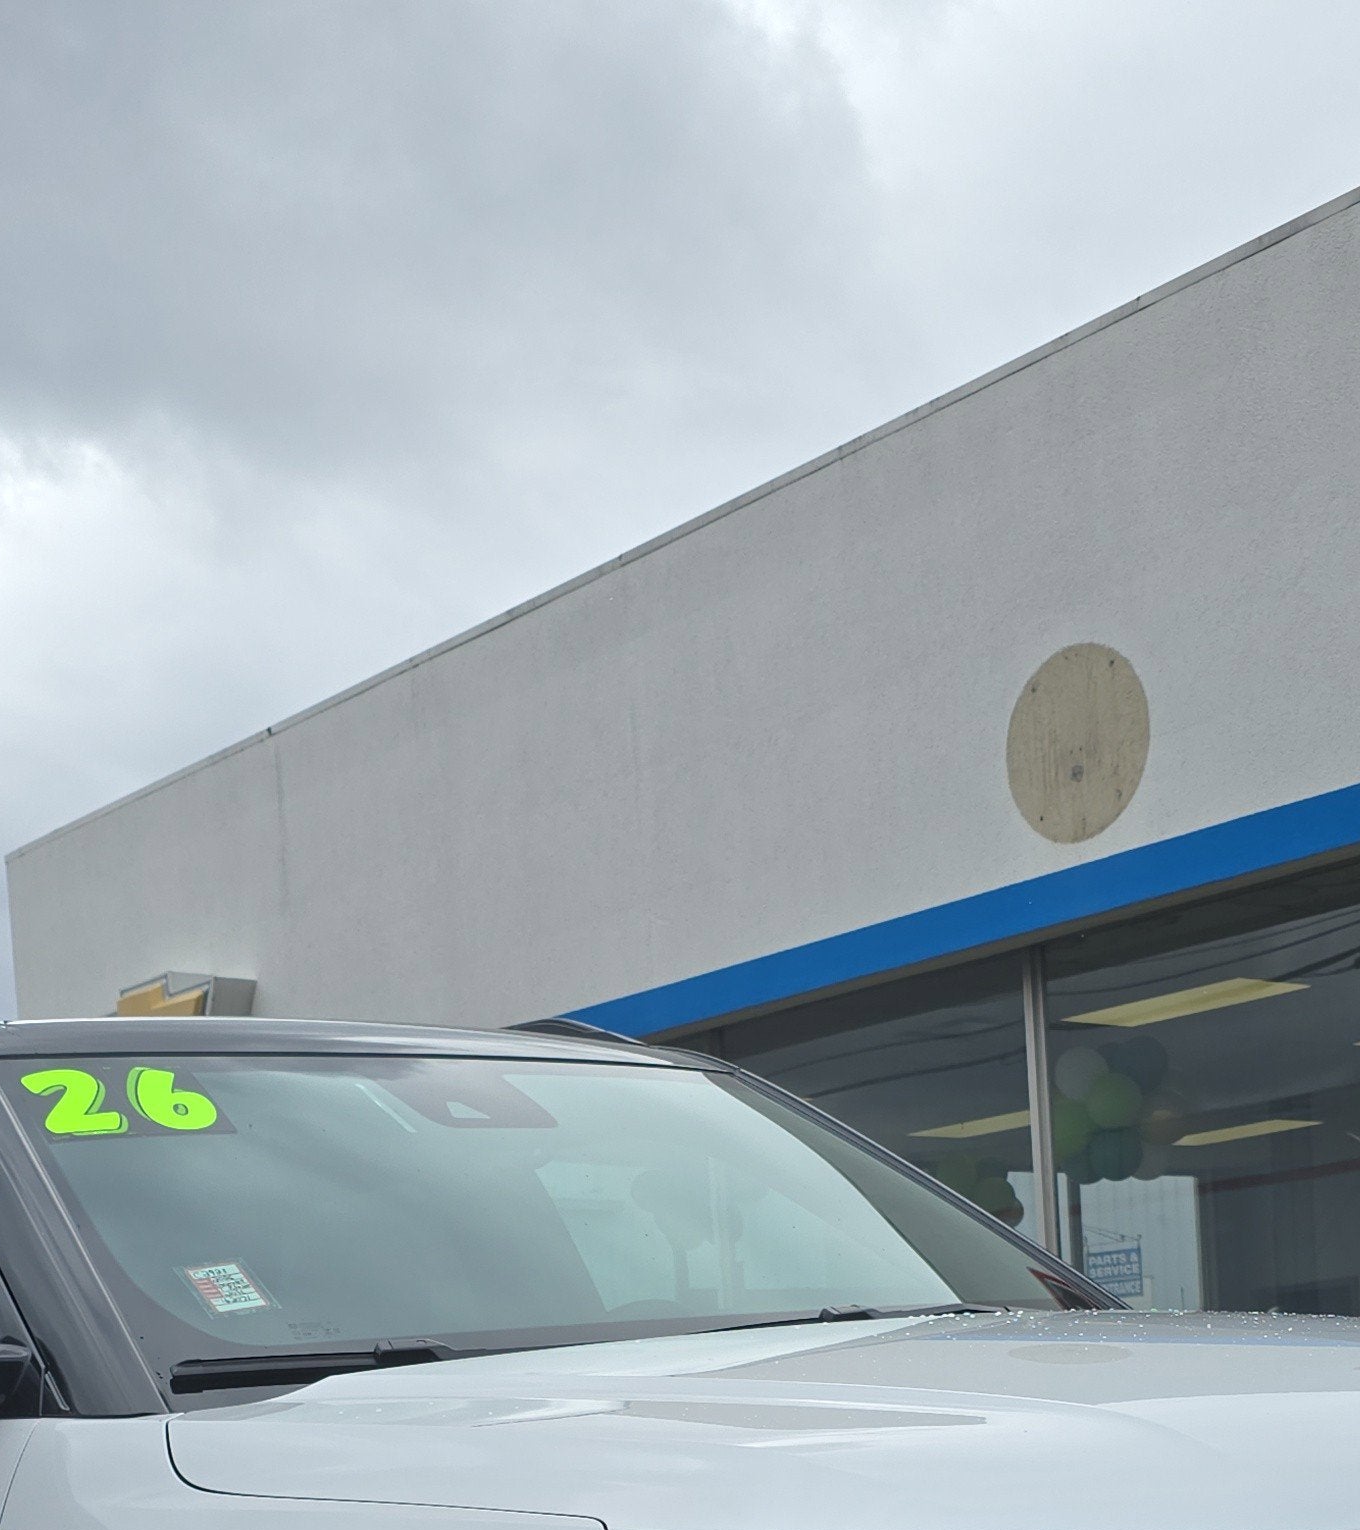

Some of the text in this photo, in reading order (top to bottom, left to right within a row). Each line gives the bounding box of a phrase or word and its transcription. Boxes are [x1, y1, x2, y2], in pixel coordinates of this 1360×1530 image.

[21, 1067, 217, 1135] 26
[1088, 1251, 1139, 1267] PARTS &
[1089, 1263, 1140, 1278] SERVICE
